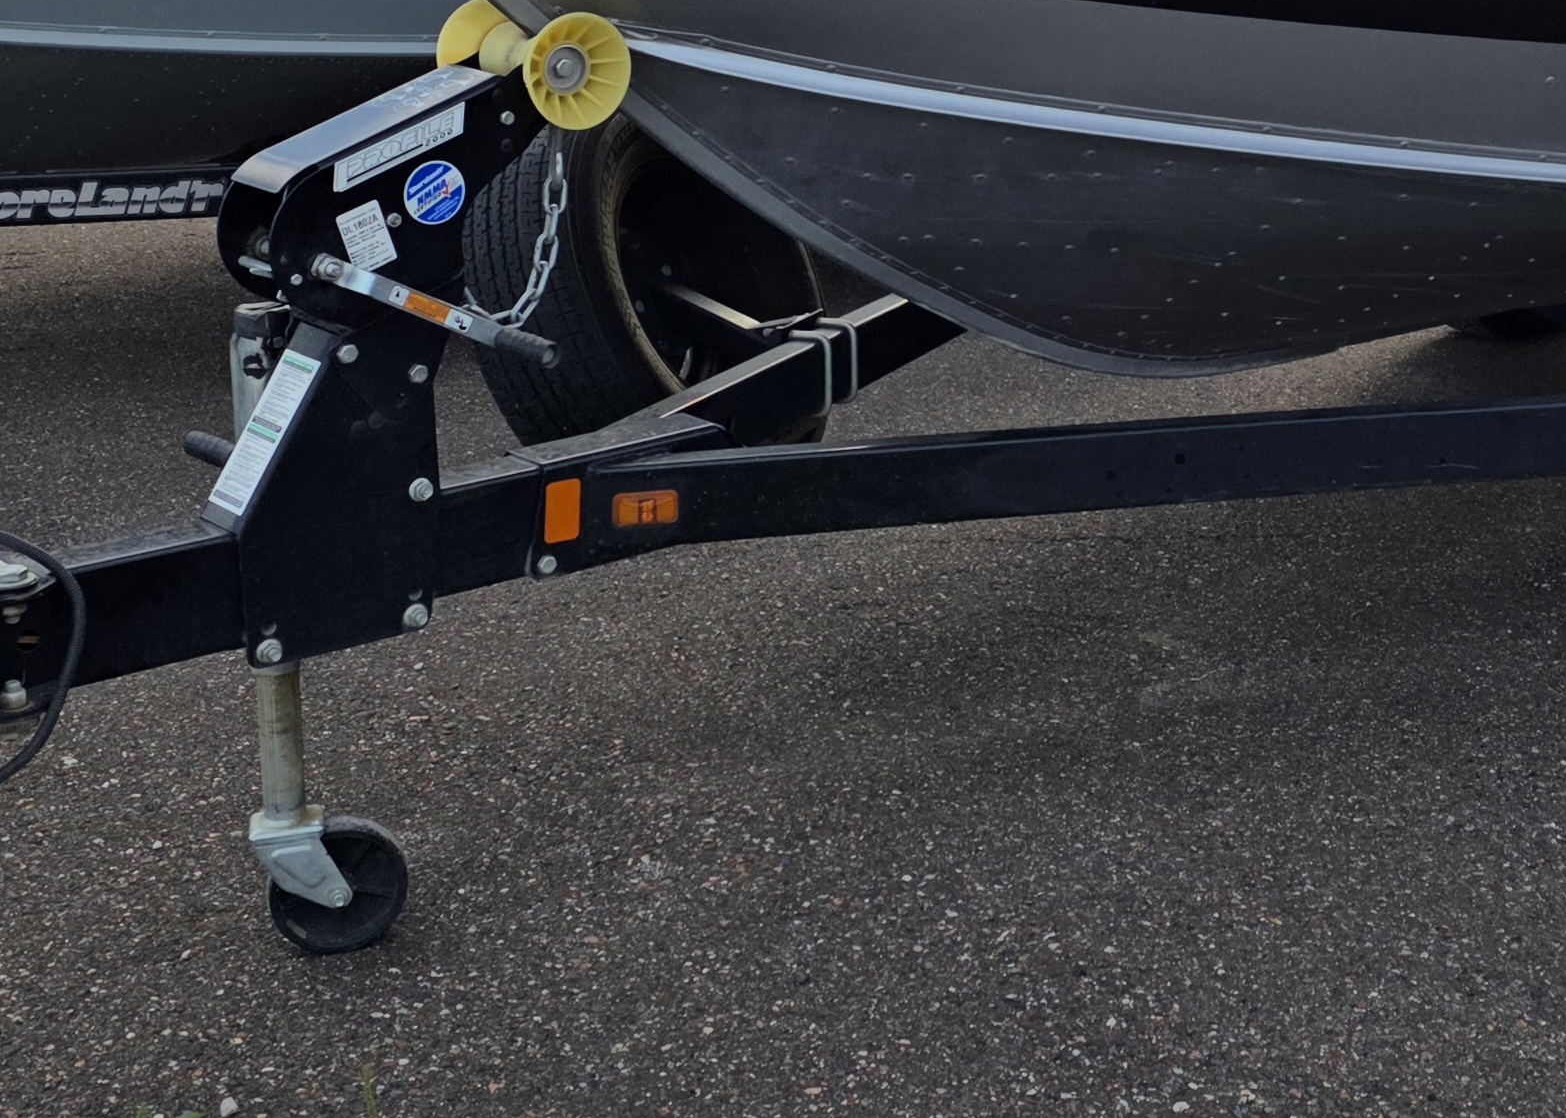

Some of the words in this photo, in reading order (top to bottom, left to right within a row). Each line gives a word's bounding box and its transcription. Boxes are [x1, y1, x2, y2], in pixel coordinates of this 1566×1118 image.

[345, 111, 454, 179] PROFILE
[425, 128, 454, 147] 2000
[416, 178, 447, 209] NMMA
